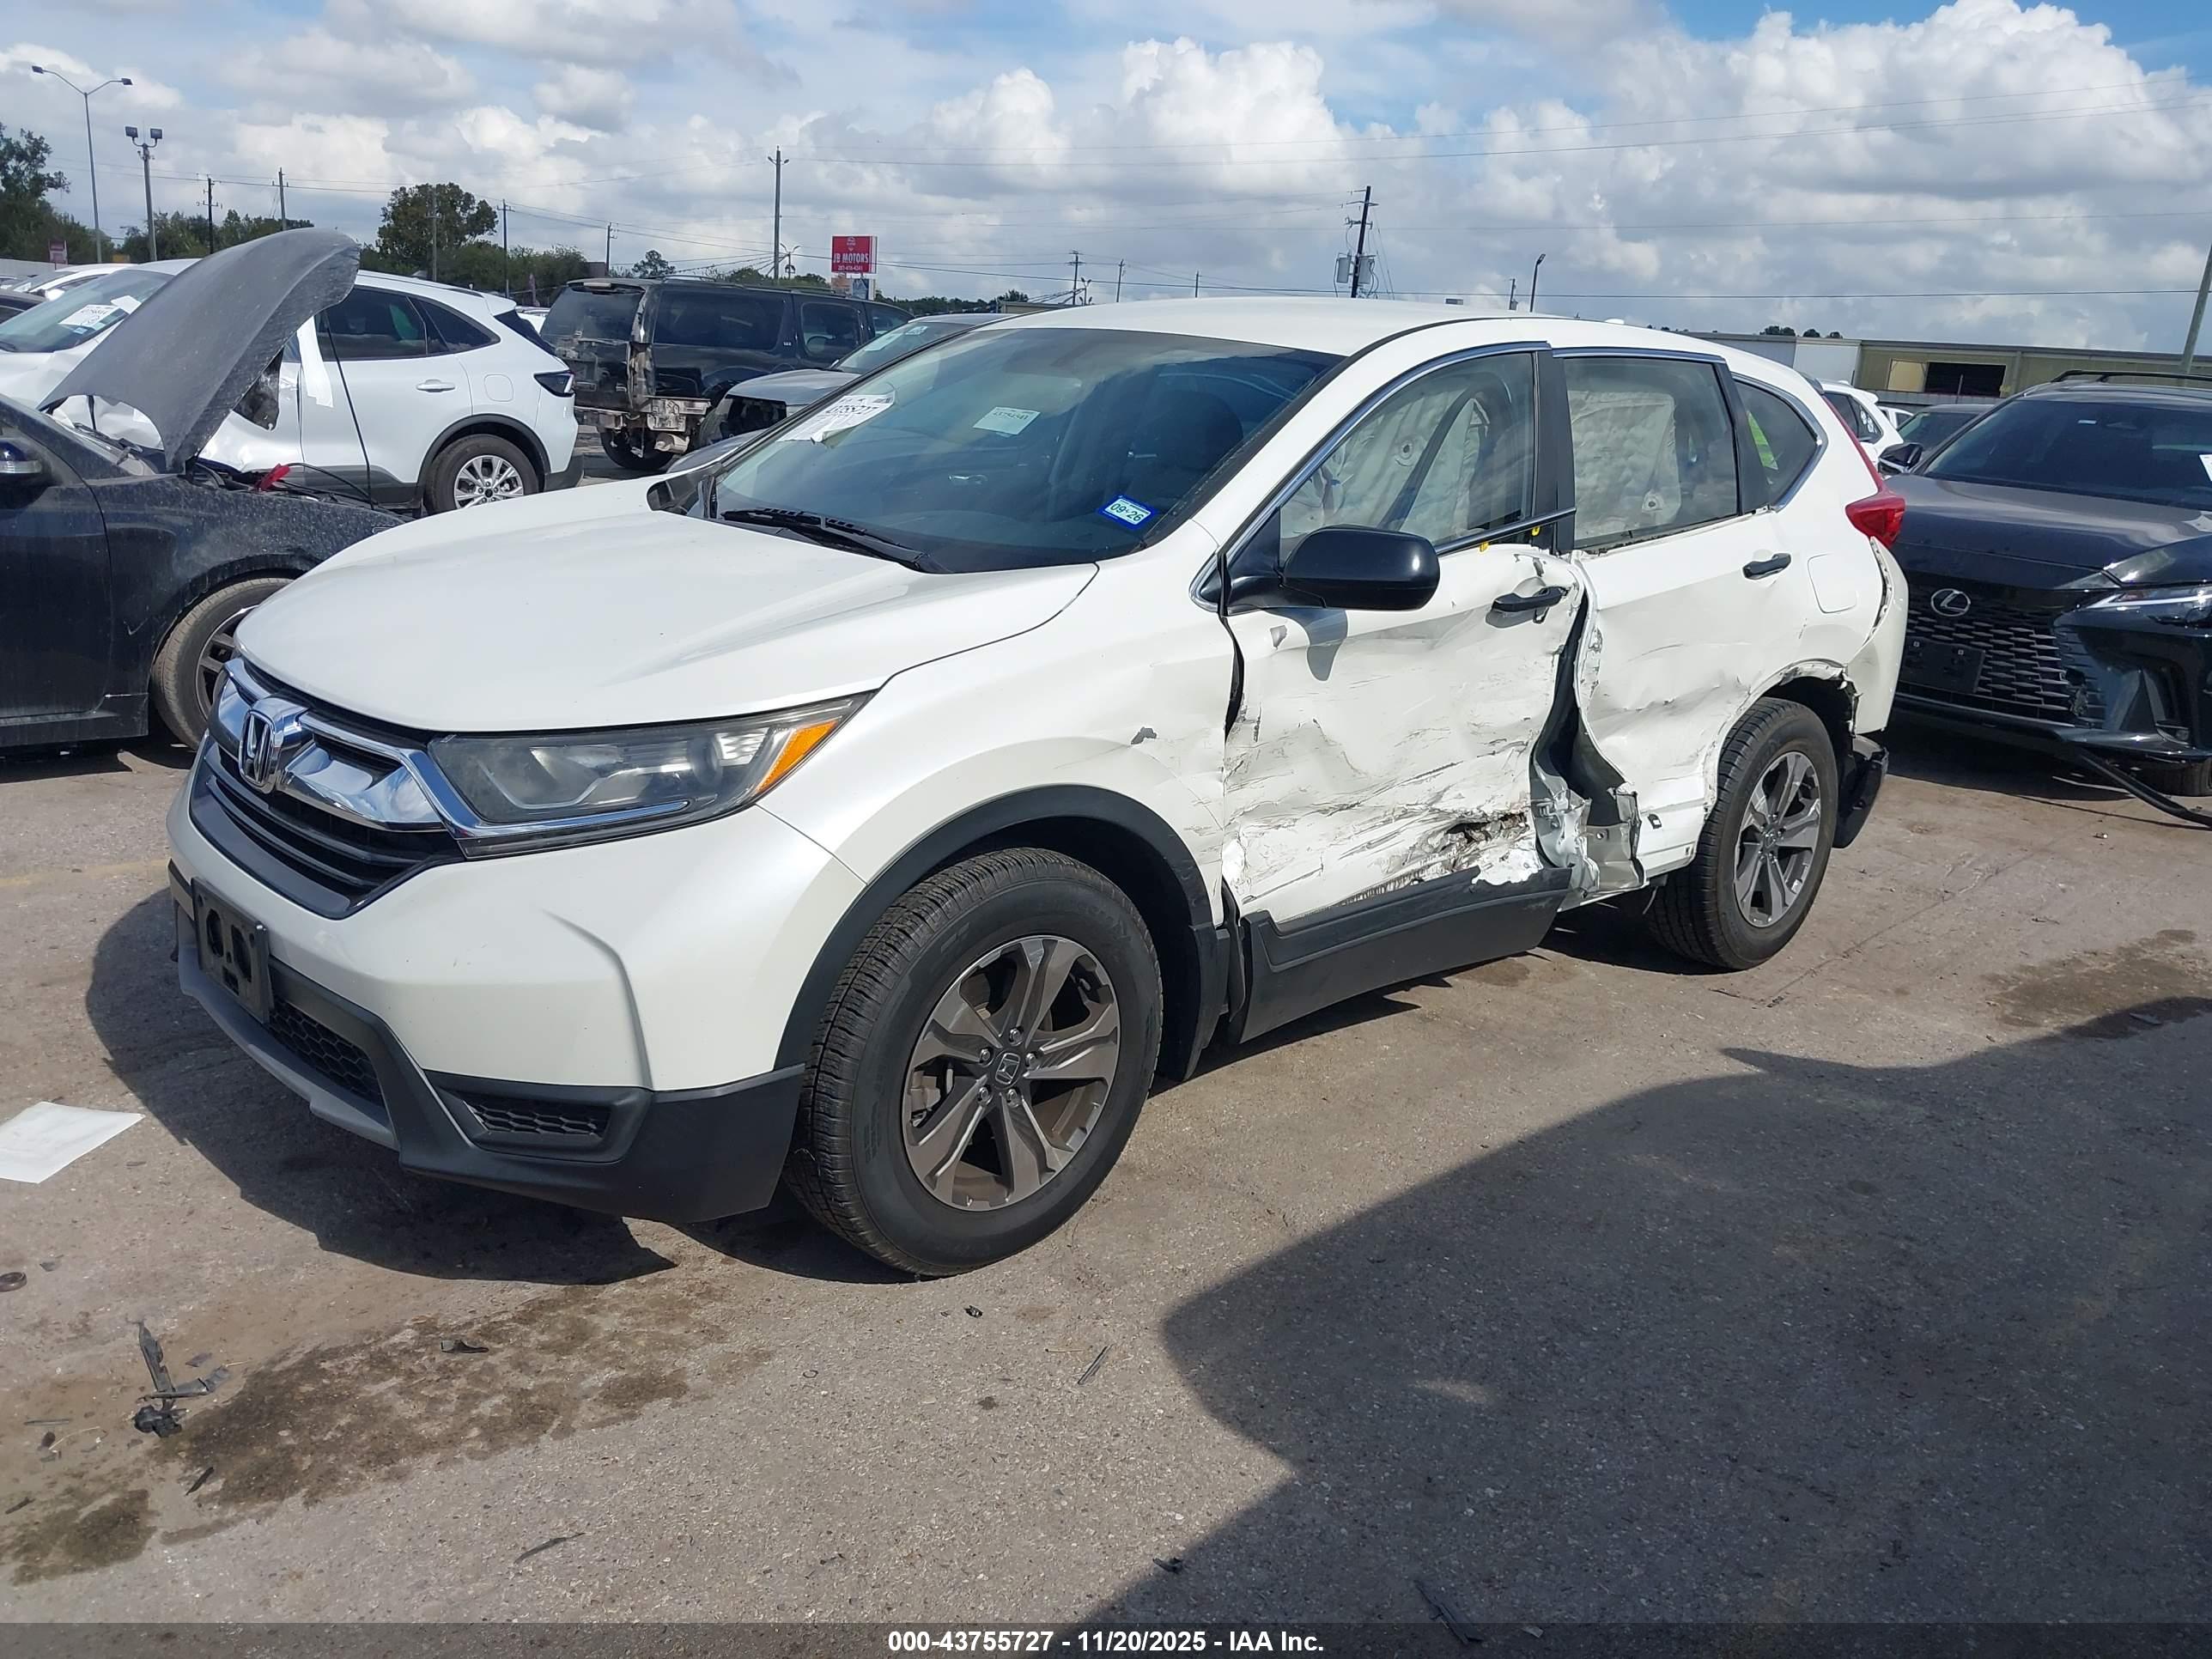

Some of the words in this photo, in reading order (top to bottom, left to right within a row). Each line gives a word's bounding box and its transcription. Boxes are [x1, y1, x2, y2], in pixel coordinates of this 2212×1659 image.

[842, 252, 869, 264] MOTORS
[1110, 503, 1127, 513] 09
[1127, 511, 1144, 521] 26
